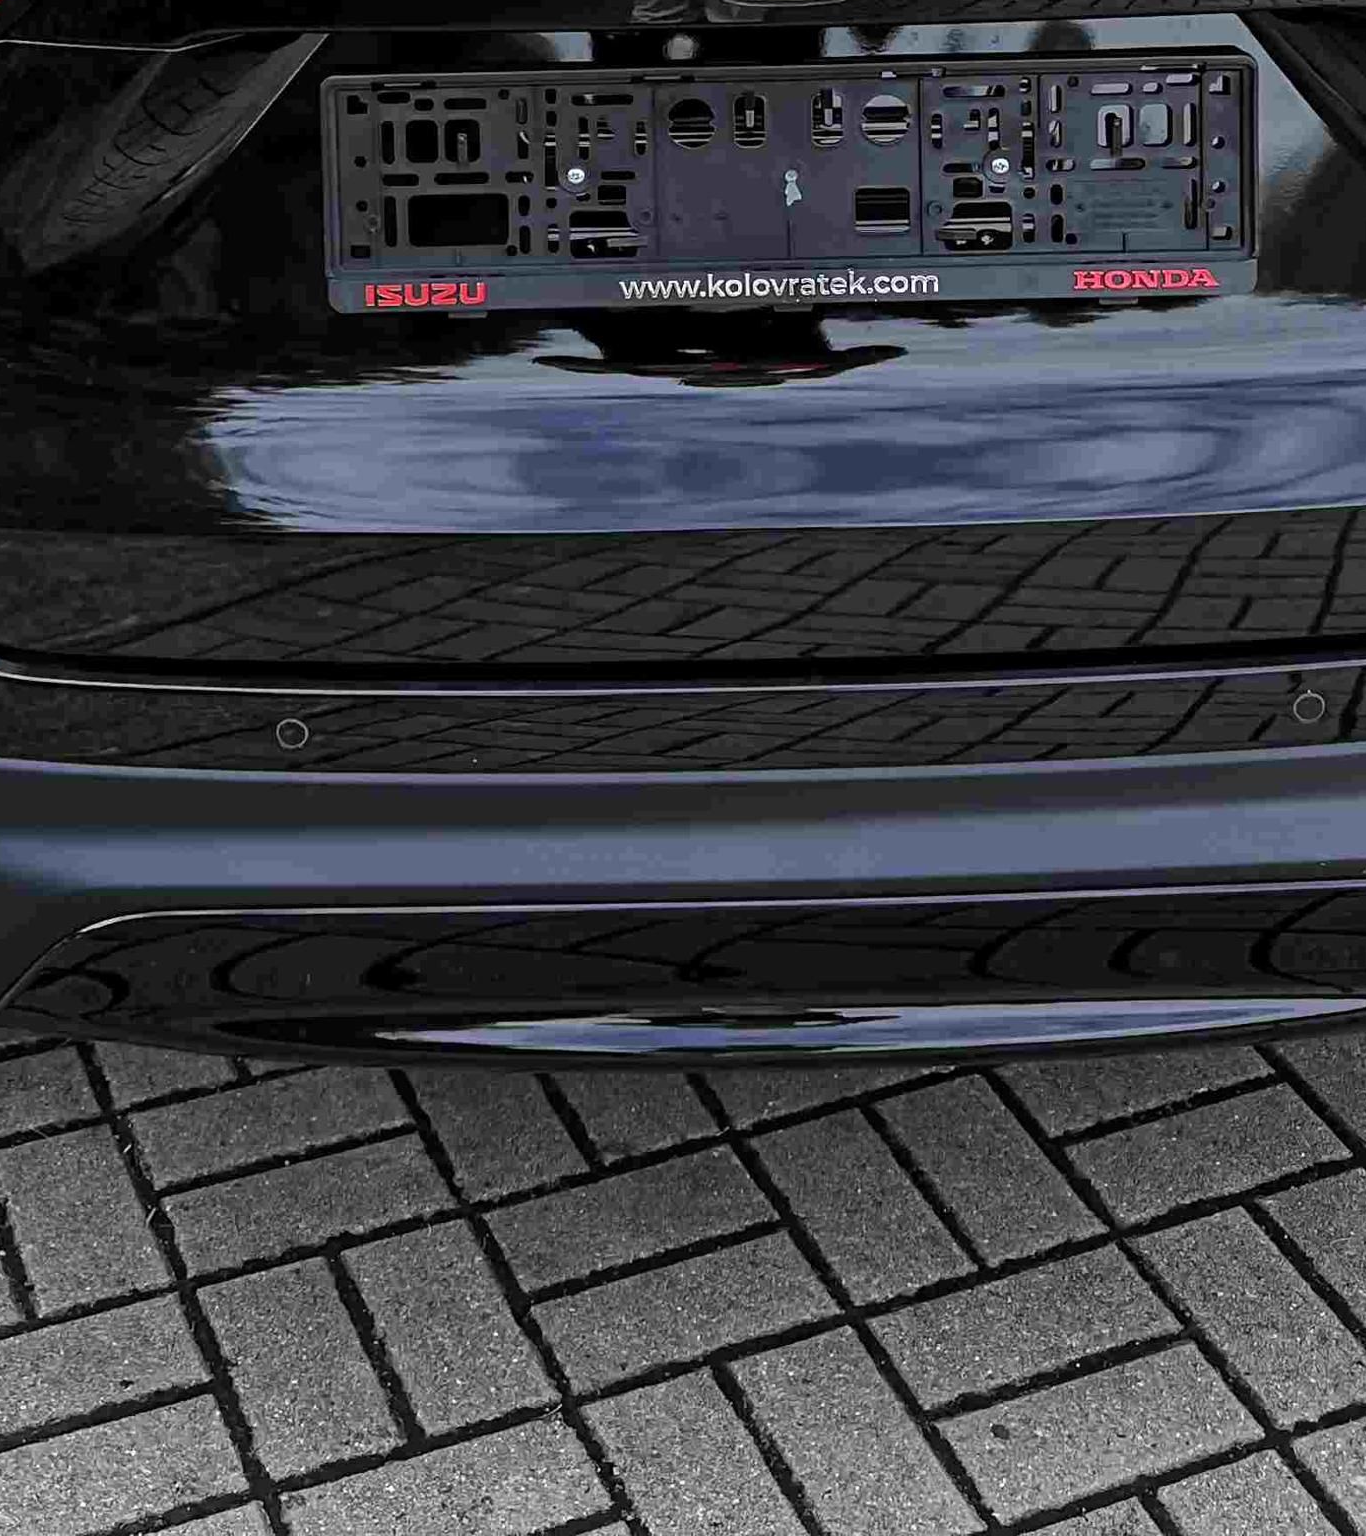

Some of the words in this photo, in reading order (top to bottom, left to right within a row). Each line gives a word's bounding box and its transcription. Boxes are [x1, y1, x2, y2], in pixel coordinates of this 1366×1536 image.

[619, 269, 940, 300] www.kolovratek.com
[1073, 268, 1220, 291] HONDA
[363, 282, 487, 308] ISUZU
